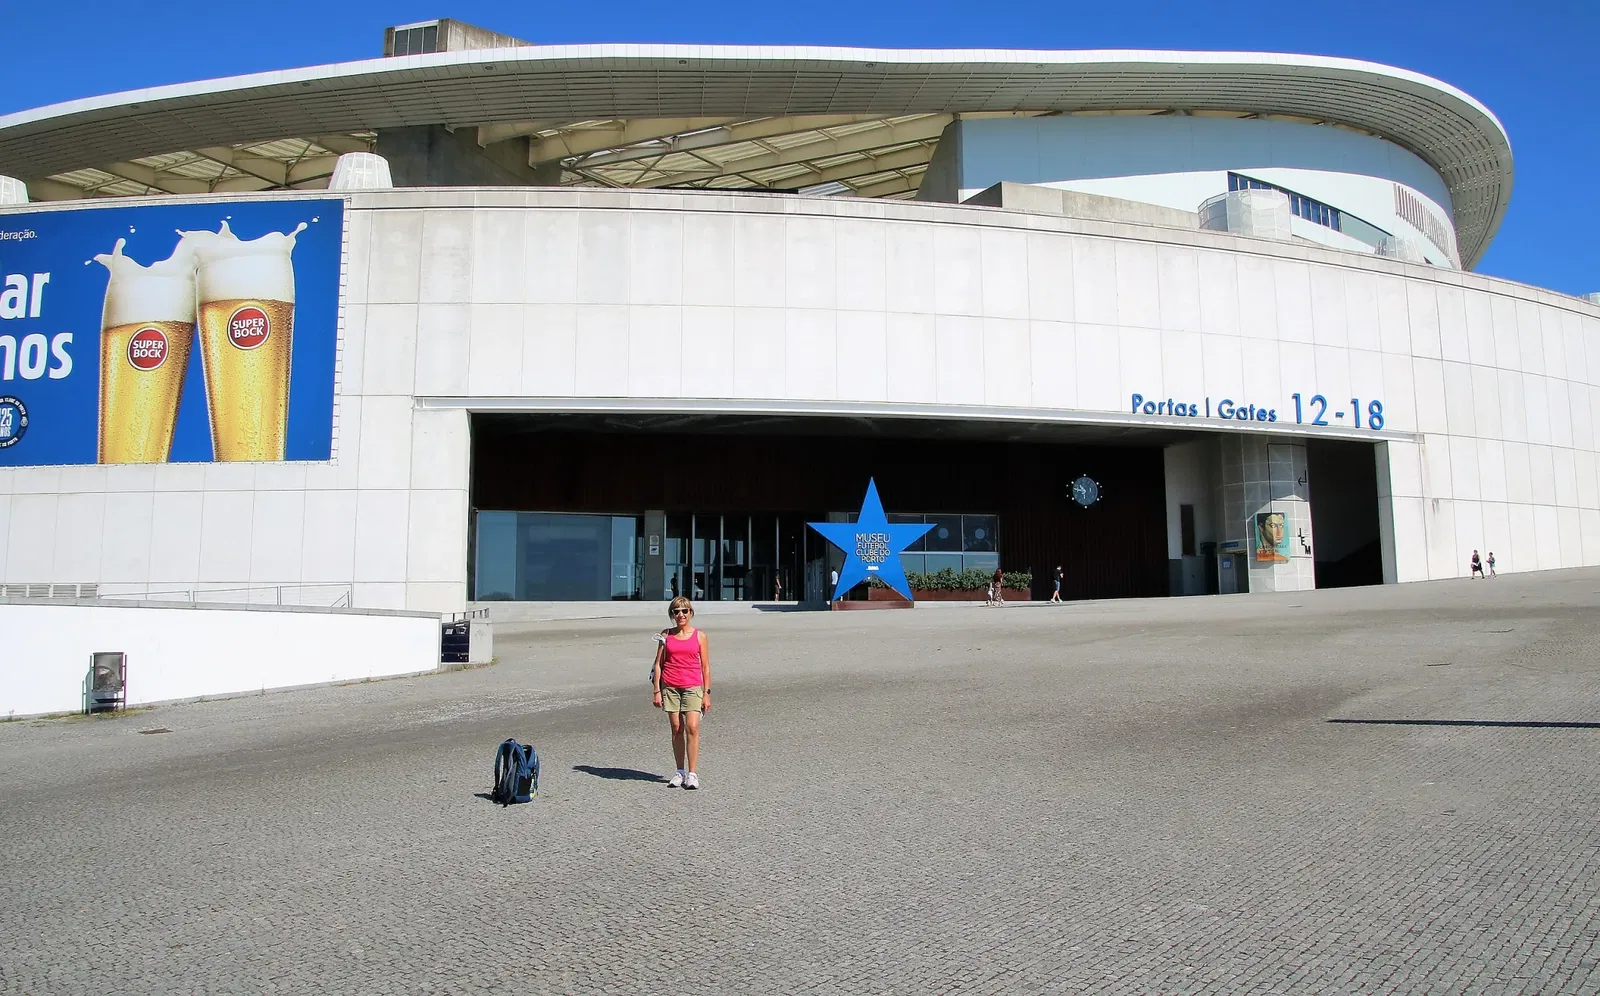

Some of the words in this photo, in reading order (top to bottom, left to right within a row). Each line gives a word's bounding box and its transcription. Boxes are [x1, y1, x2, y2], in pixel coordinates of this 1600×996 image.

[0, 272, 51, 320] ar
[232, 317, 265, 330] SUPER
[233, 326, 264, 339] BOCK
[132, 339, 164, 350] SUPER
[133, 348, 162, 359] BOCK
[1132, 393, 1198, 417] Portas
[1217, 398, 1278, 422] Gates
[1291, 393, 1385, 430] 12-18
[855, 533, 891, 543] MUSEU
